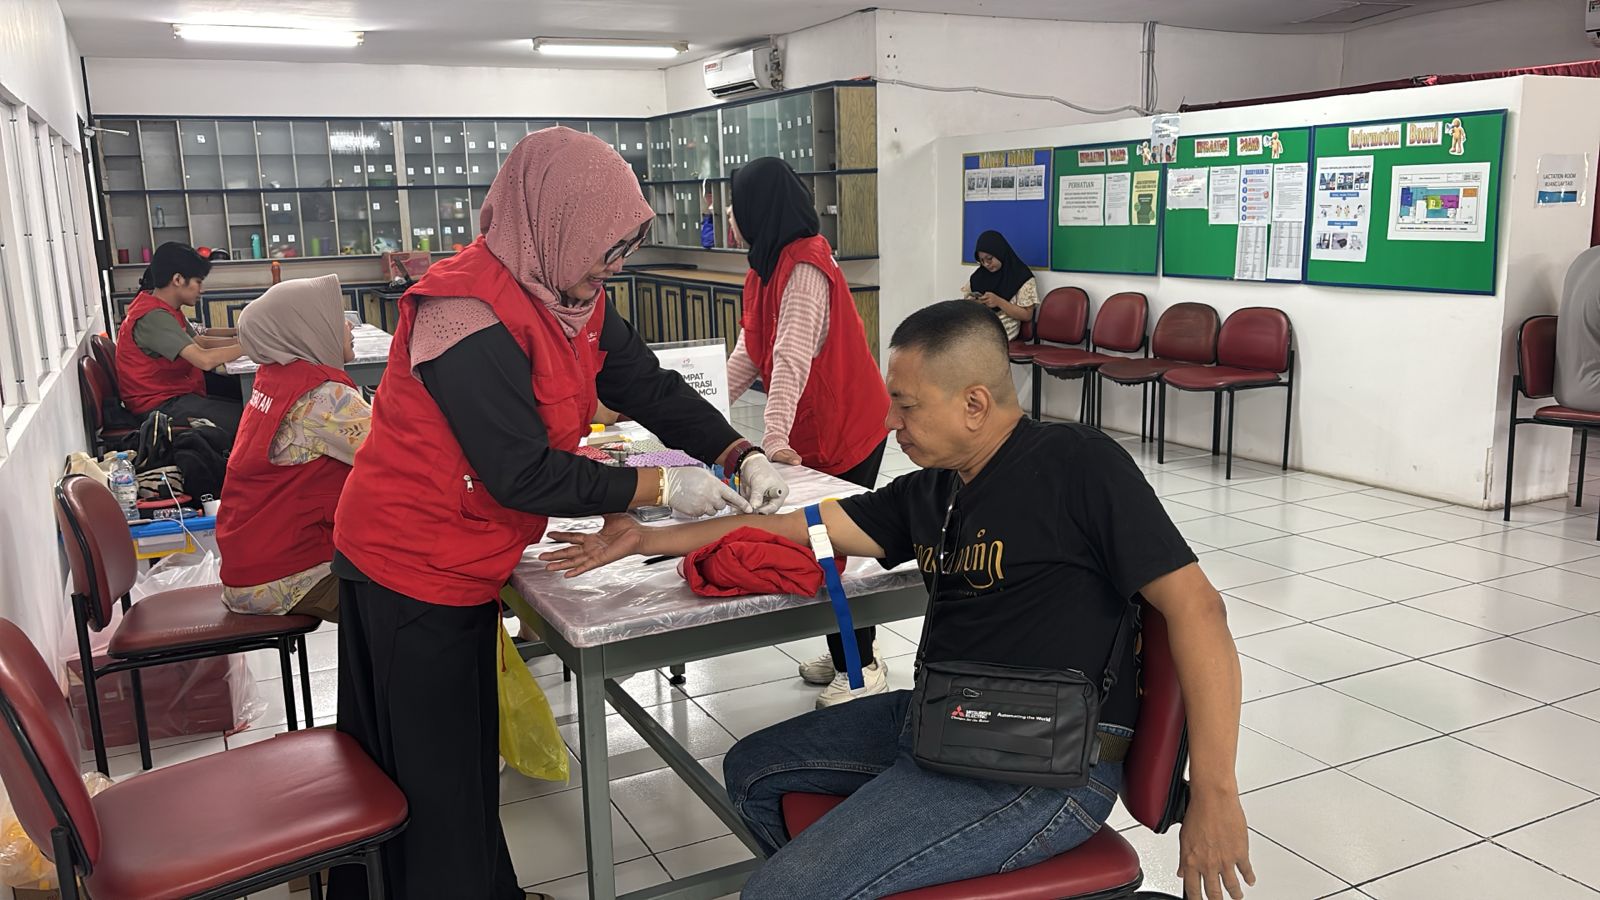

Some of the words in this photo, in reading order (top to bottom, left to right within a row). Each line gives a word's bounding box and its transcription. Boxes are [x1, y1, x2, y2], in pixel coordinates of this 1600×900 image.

[1409, 122, 1439, 144] Board
[682, 373, 704, 381] MPAT
[689, 380, 713, 388] TRASI
[997, 712, 1026, 720] Automating
